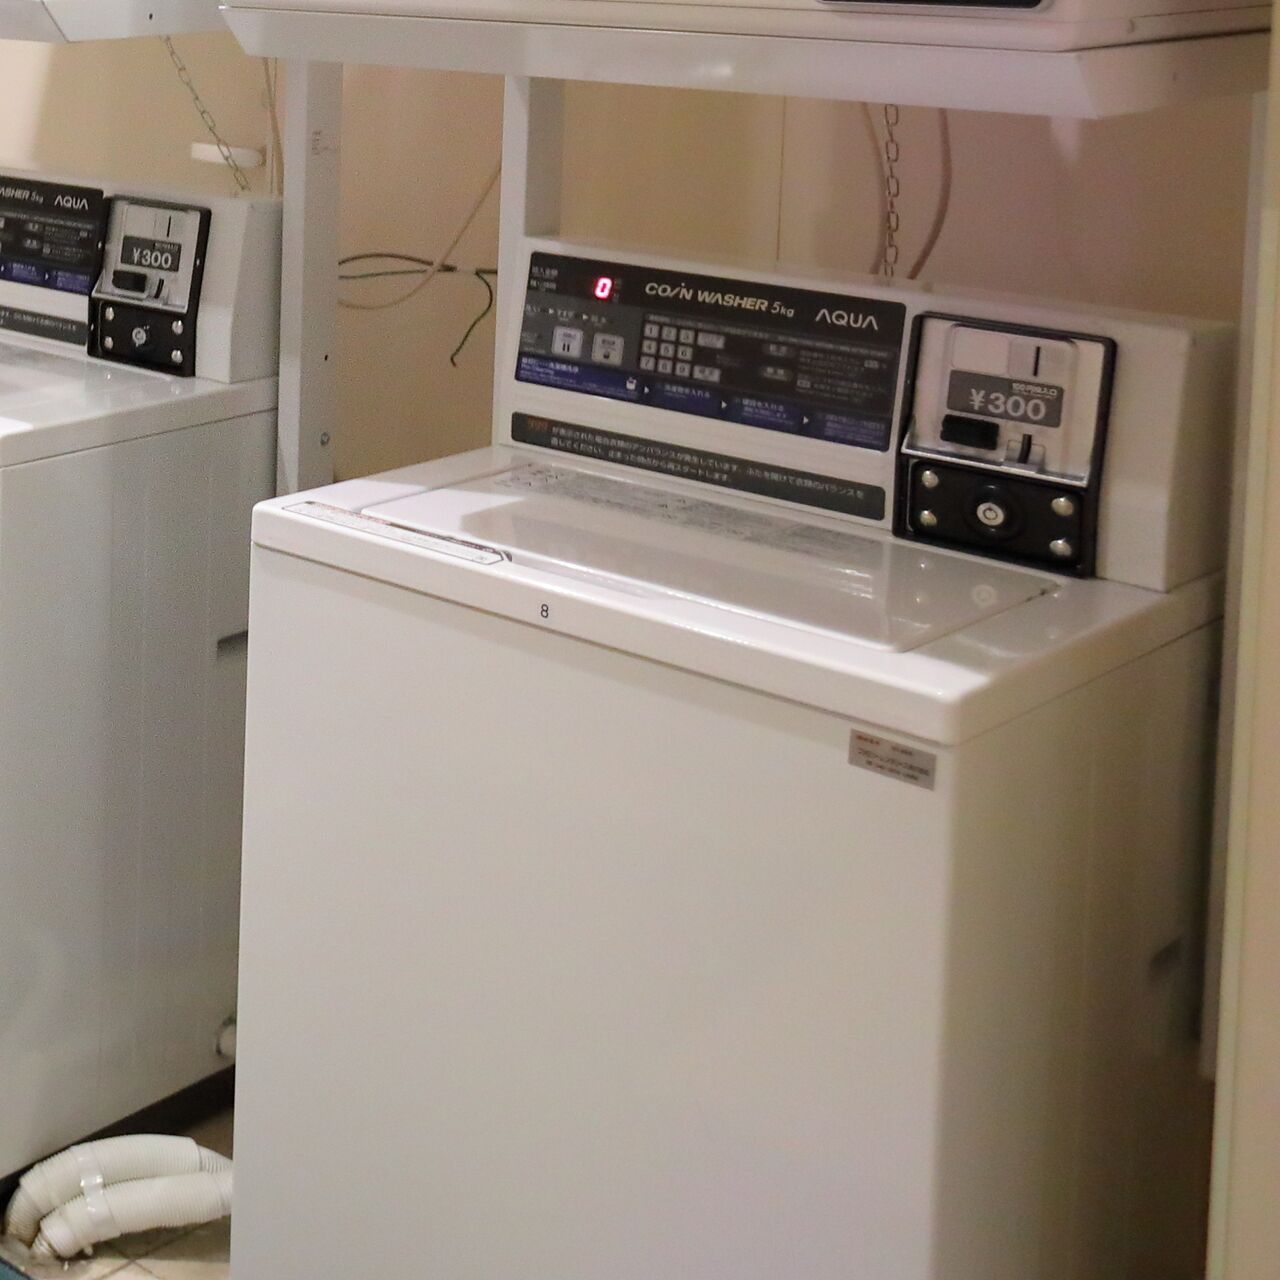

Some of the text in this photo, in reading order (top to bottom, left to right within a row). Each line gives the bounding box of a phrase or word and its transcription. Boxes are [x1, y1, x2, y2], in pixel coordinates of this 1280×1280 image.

[54, 194, 89, 211] AQUA
[132, 247, 172, 269] ¥300
[594, 276, 613, 300] 0
[696, 289, 770, 312] WASHER
[770, 301, 795, 318] 5kg
[815, 308, 879, 331] AQUA
[969, 387, 1047, 421] ¥300
[540, 604, 549, 618] 8
